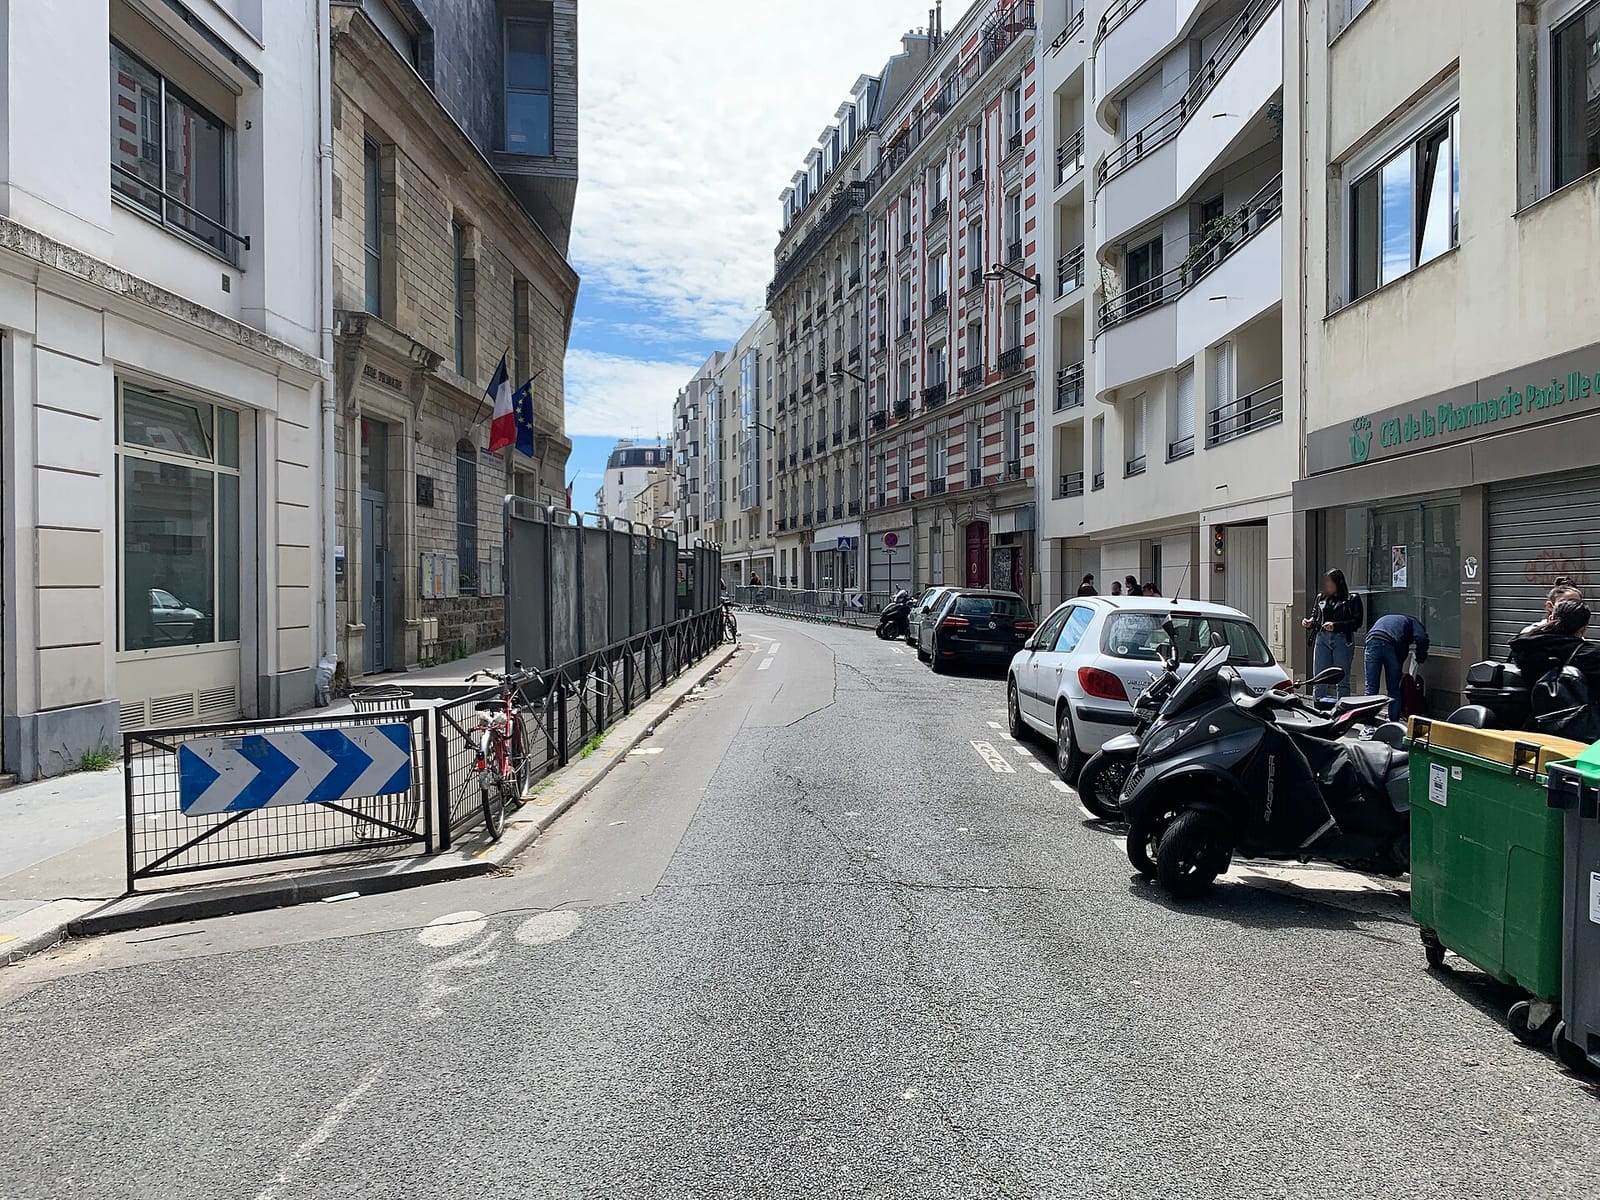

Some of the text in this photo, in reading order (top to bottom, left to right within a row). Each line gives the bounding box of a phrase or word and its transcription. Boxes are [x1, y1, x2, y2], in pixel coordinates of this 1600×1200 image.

[1379, 417, 1401, 449] CFA
[1403, 413, 1420, 443] de
[1422, 409, 1435, 438] la
[1438, 385, 1522, 434] Pharmacie
[1524, 377, 1564, 412] Paris
[1567, 370, 1590, 402] Ile
